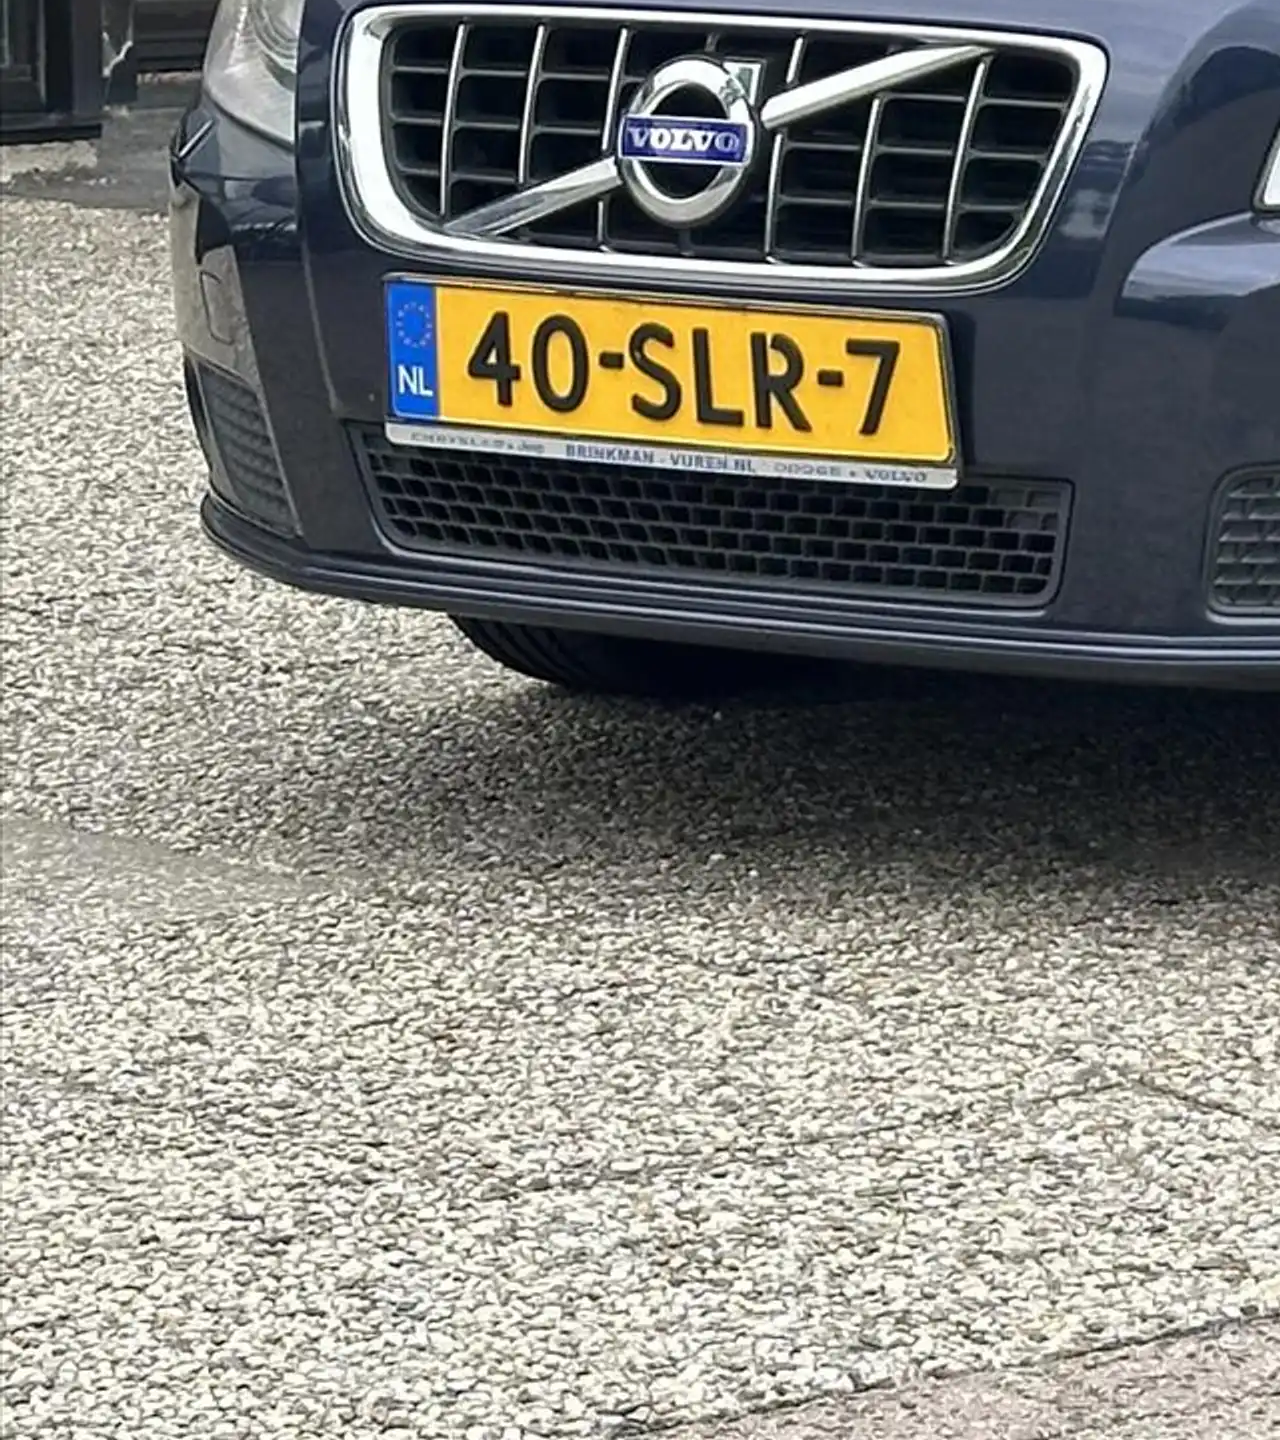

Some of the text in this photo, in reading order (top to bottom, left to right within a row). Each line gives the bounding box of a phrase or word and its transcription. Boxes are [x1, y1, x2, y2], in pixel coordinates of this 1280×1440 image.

[627, 127, 740, 153] VOLVO
[398, 364, 434, 398] NL
[467, 310, 901, 436] 40-SLR-7
[565, 443, 655, 465] BRINKMAN
[864, 467, 929, 484] VOLVO
